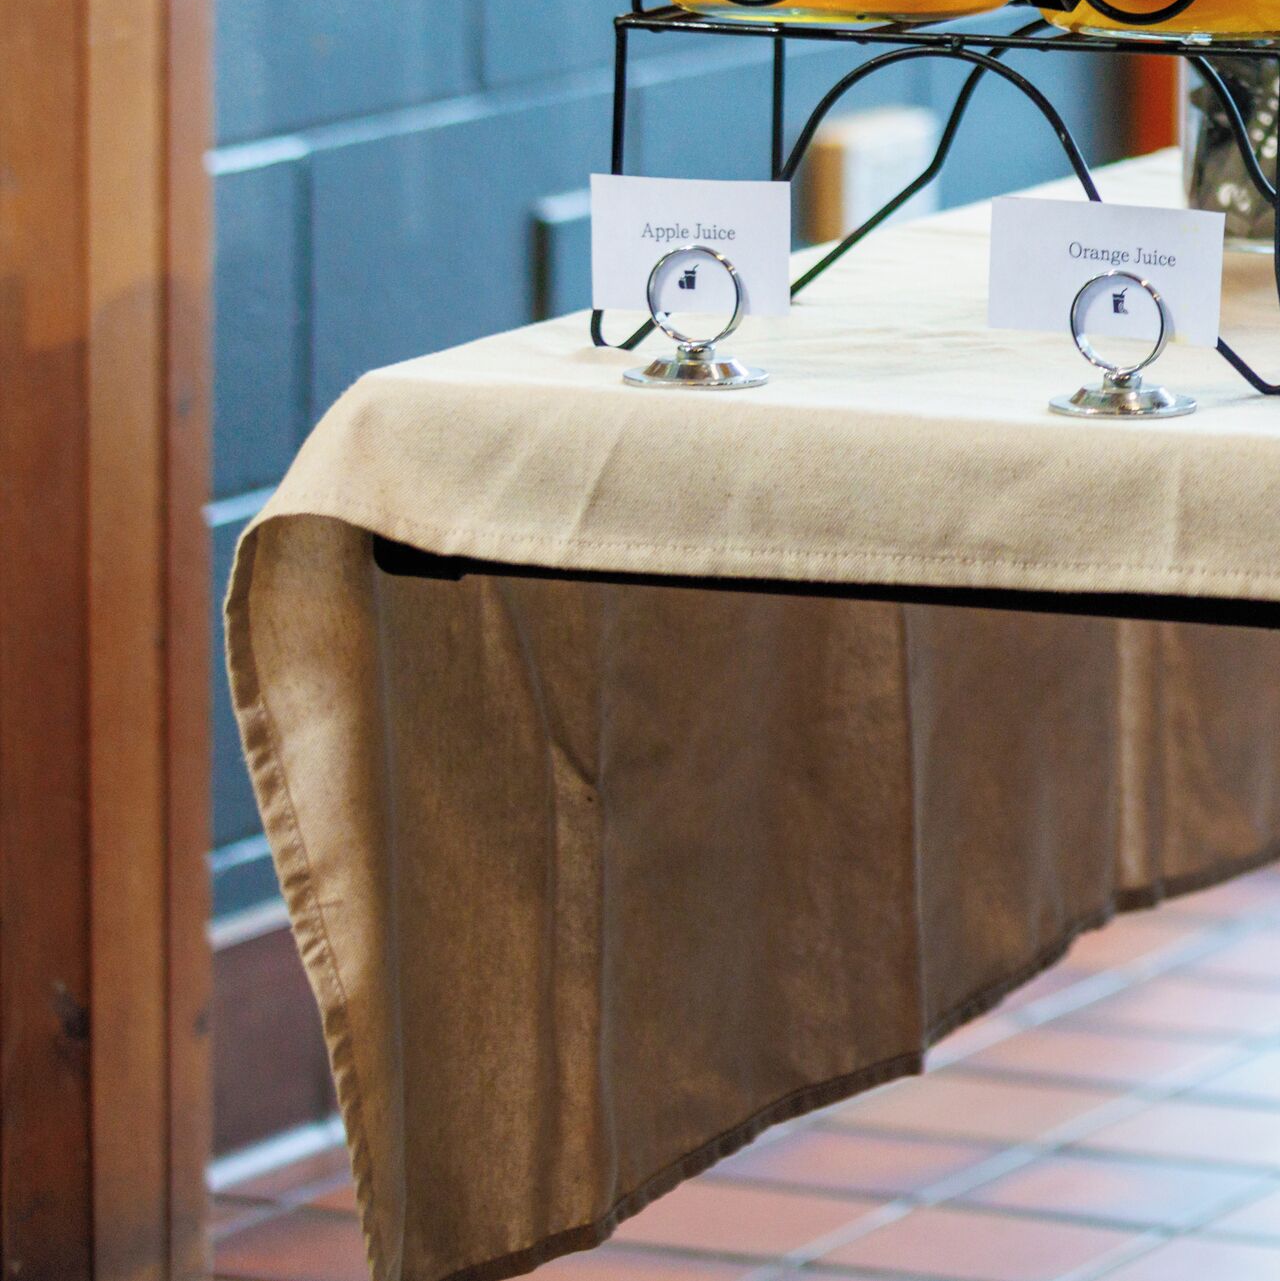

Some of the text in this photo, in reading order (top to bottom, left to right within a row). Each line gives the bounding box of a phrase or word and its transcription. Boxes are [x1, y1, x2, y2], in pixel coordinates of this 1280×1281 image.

[641, 222, 736, 243] Apple Juice
[1068, 241, 1177, 268] Orange Juice
